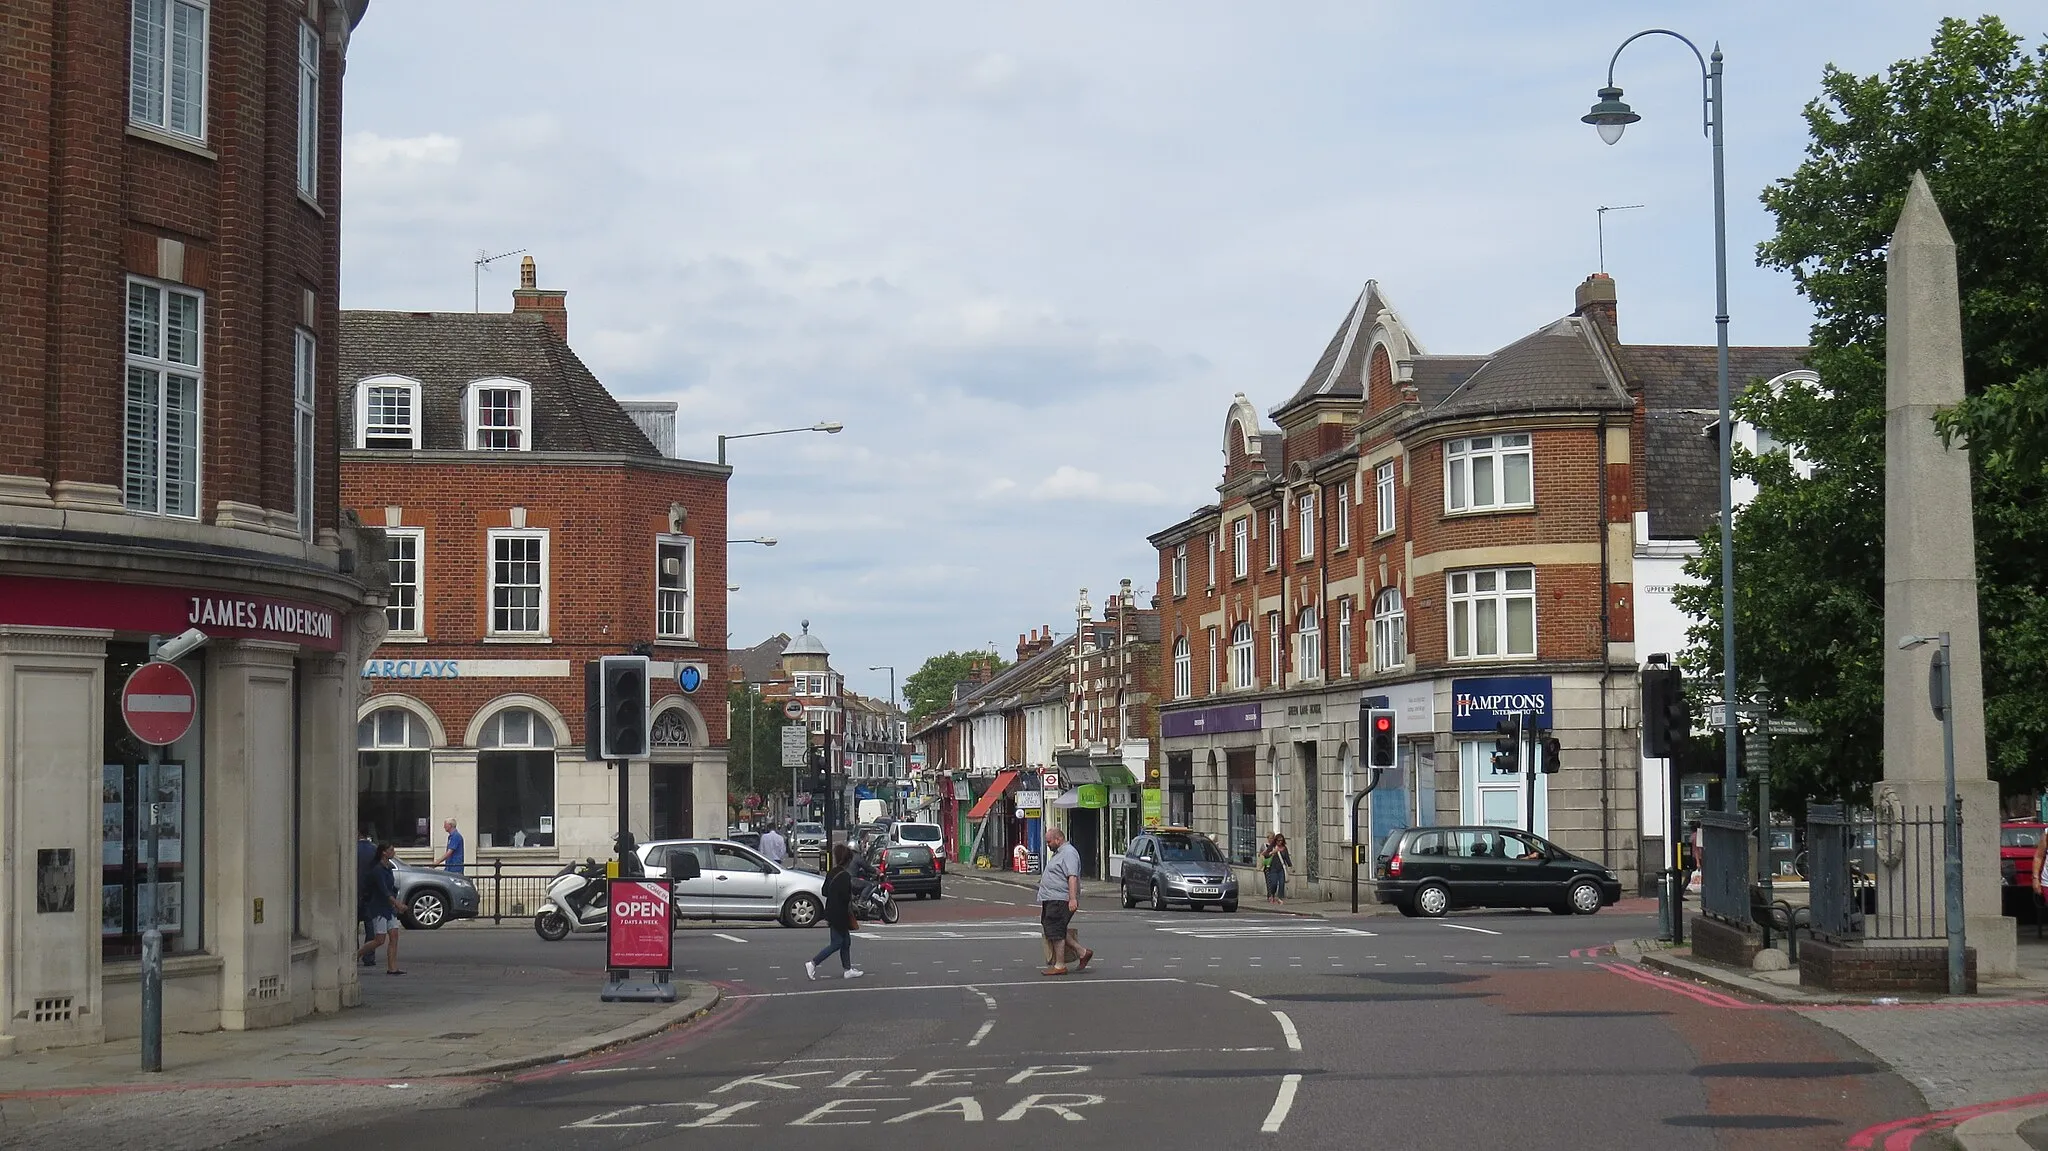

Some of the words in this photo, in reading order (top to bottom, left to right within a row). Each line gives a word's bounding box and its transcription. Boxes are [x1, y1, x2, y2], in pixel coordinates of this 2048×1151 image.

[189, 597, 257, 629] JAMES
[262, 604, 332, 639] ANDERSON
[361, 660, 459, 679] ARCLAYS
[1456, 693, 1545, 717] HAMPTONS
[615, 901, 665, 917] OPEN
[708, 1065, 1095, 1094] KEEP
[559, 1093, 1108, 1129] CLEAR
